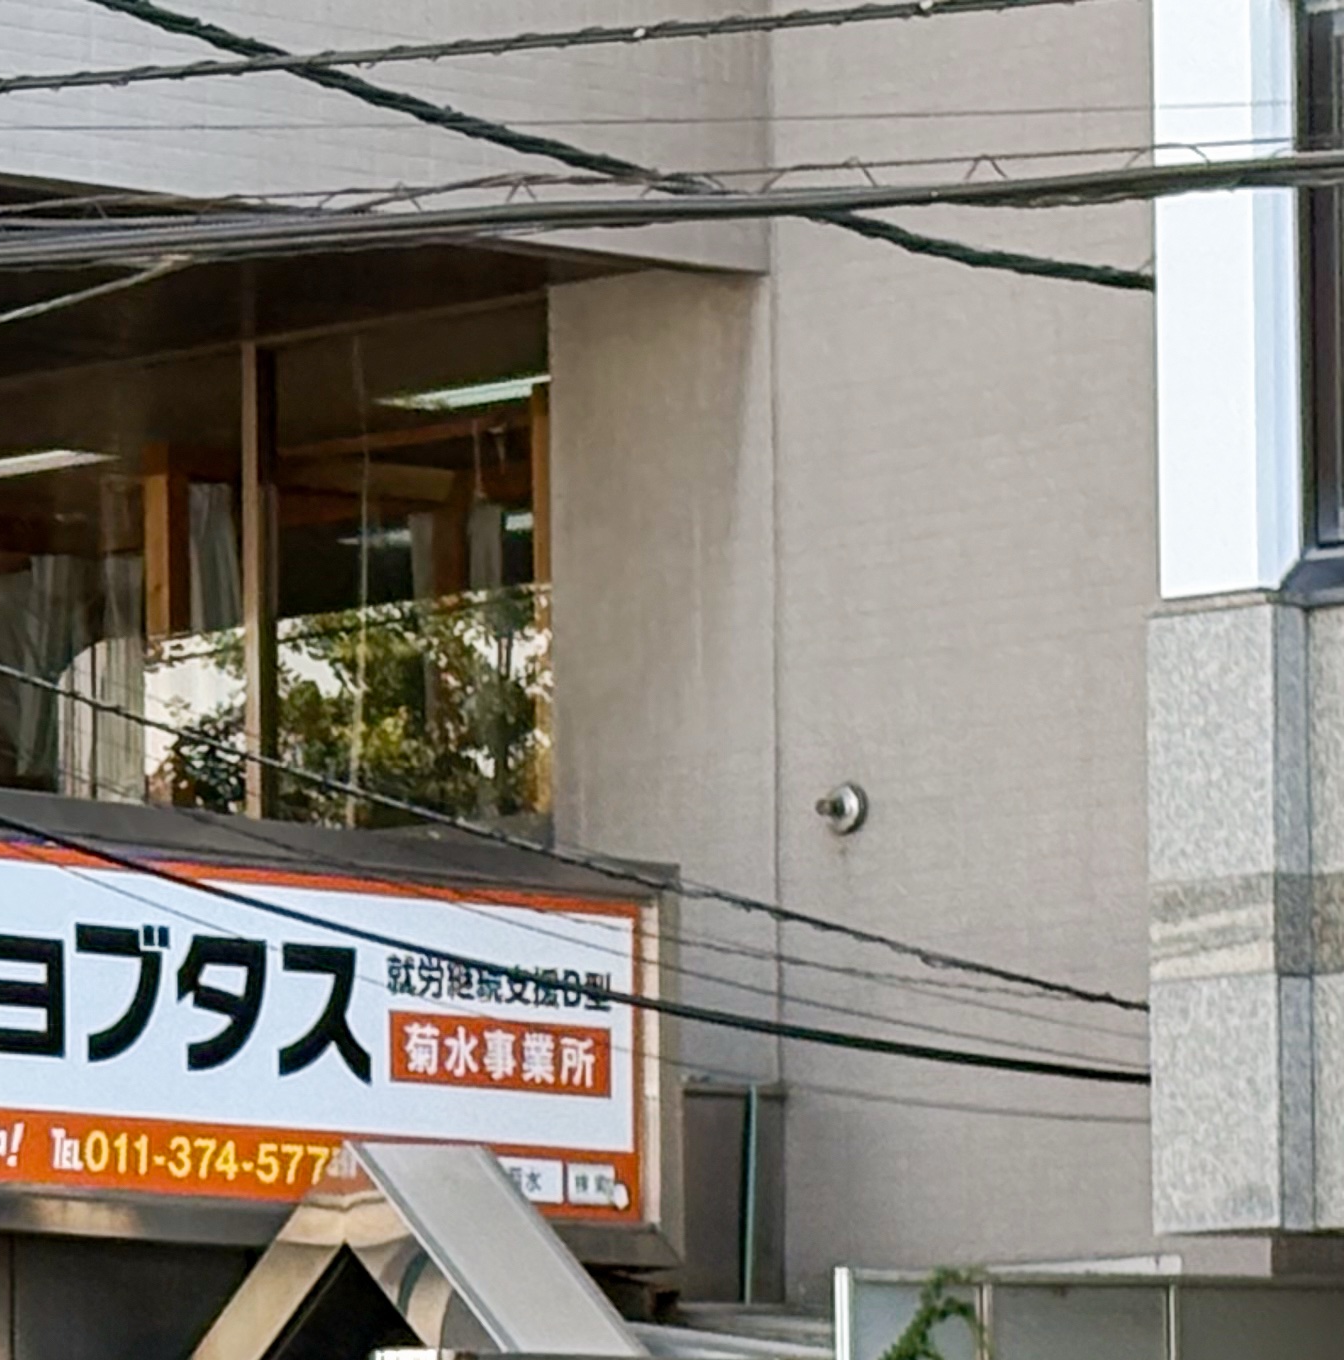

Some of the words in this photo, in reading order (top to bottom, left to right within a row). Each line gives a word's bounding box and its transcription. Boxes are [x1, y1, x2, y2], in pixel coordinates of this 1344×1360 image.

[404, 1022, 596, 1088] 菊水事業所
